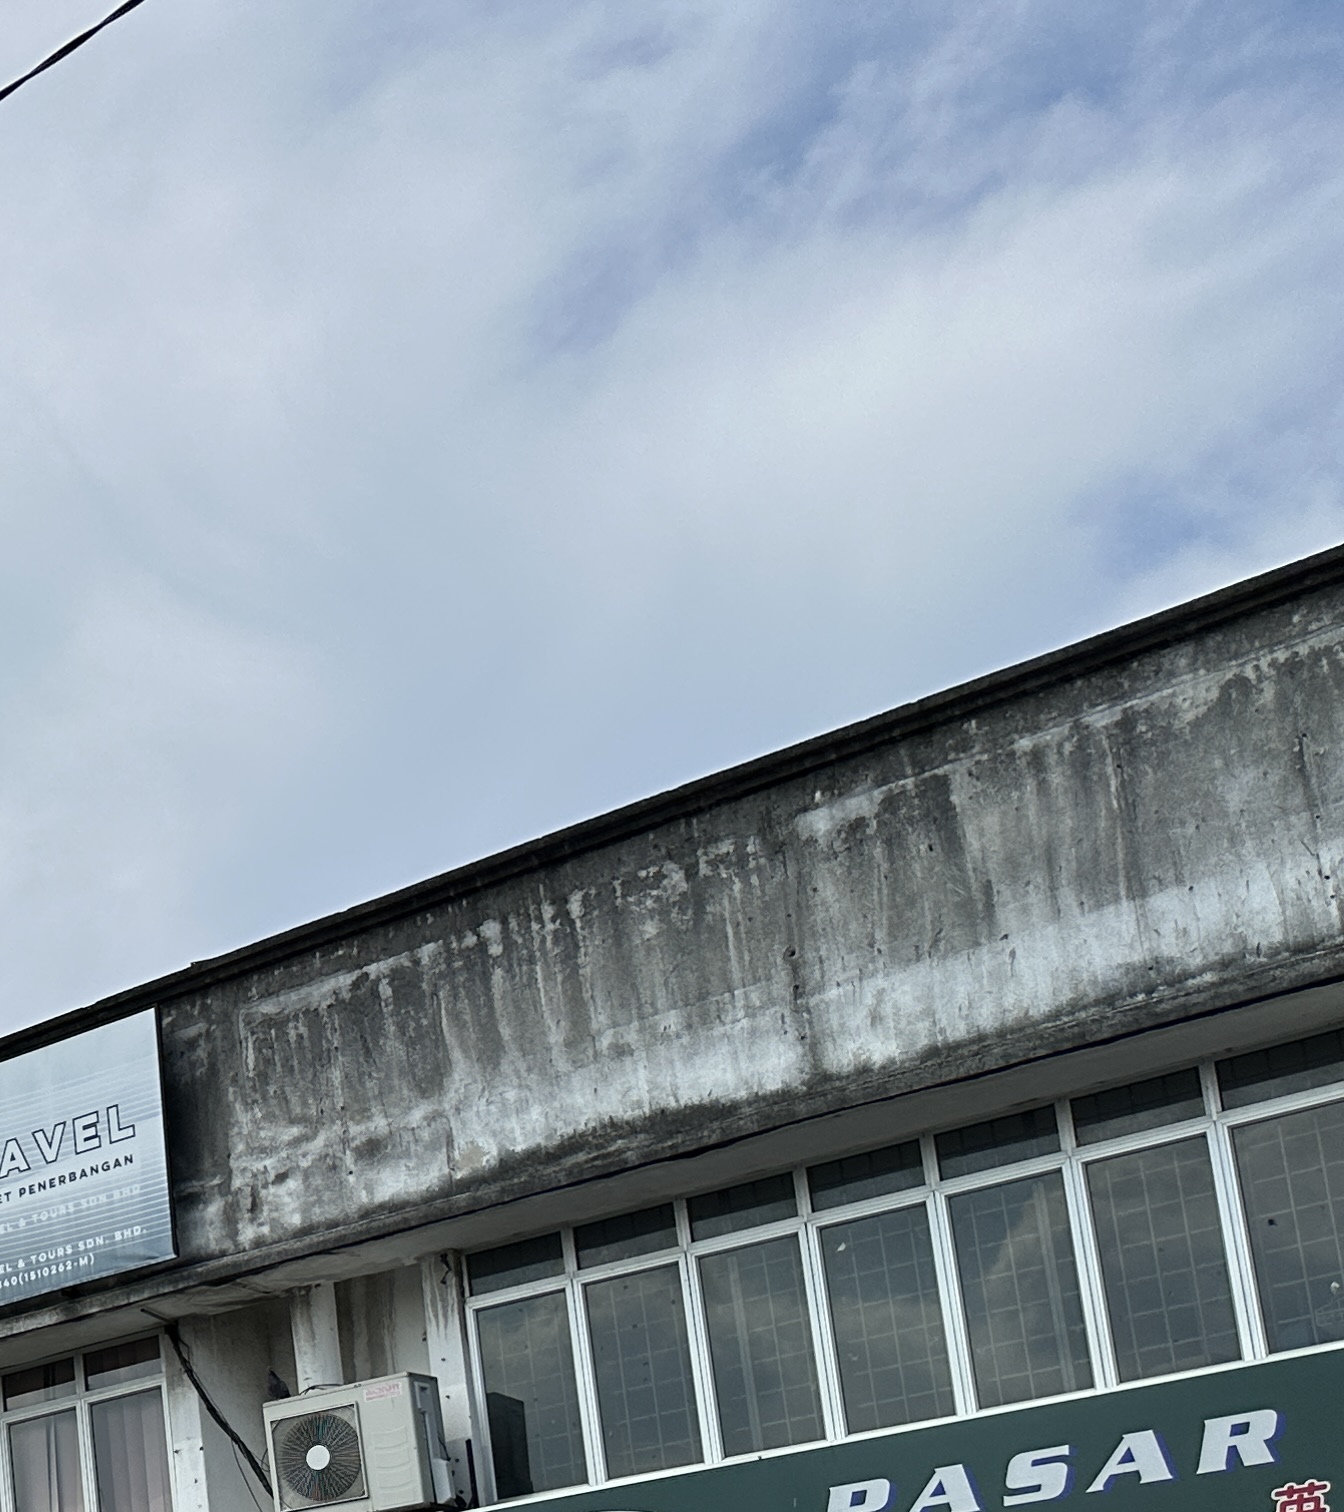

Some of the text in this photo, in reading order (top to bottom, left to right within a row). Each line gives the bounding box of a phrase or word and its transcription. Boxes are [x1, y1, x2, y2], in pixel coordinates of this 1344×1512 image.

[19, 1154, 135, 1198] PENERBANGAN
[31, 1203, 76, 1223] TOURS
[17, 1257, 25, 1269] &
[30, 1244, 74, 1266] TOURS
[77, 1236, 109, 1252] SDN.
[114, 1224, 147, 1242] BHD.
